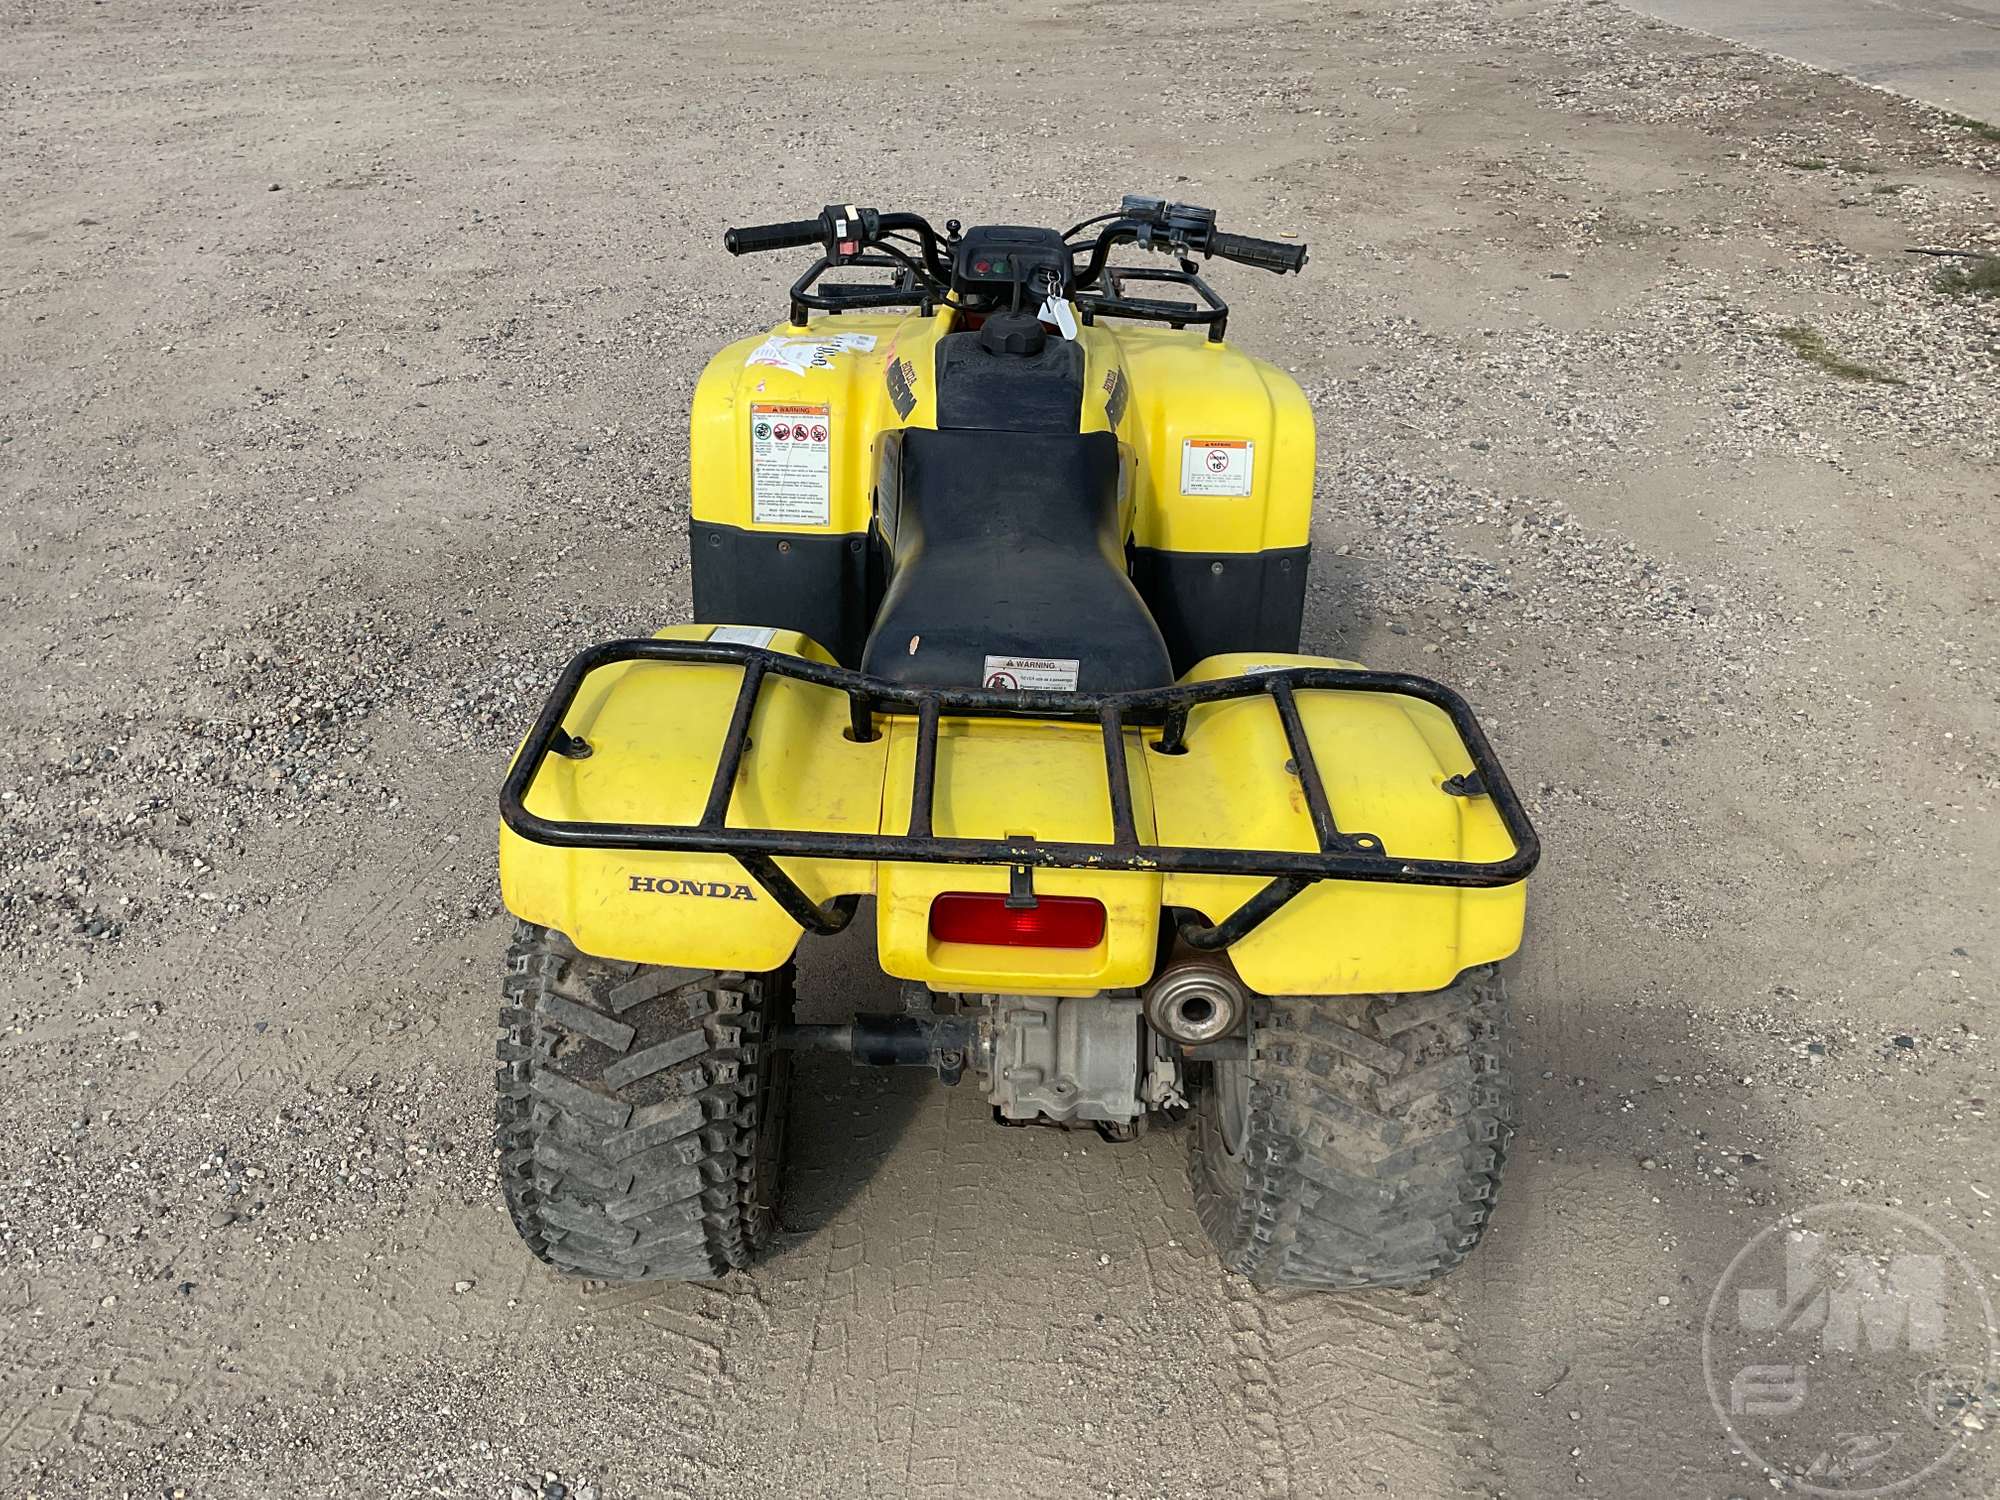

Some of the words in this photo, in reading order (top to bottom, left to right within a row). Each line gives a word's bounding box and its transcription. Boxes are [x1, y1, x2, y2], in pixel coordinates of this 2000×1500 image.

[779, 407, 810, 415] WARNING
[1016, 660, 1056, 669] WARNING
[628, 875, 758, 902] HONDA
